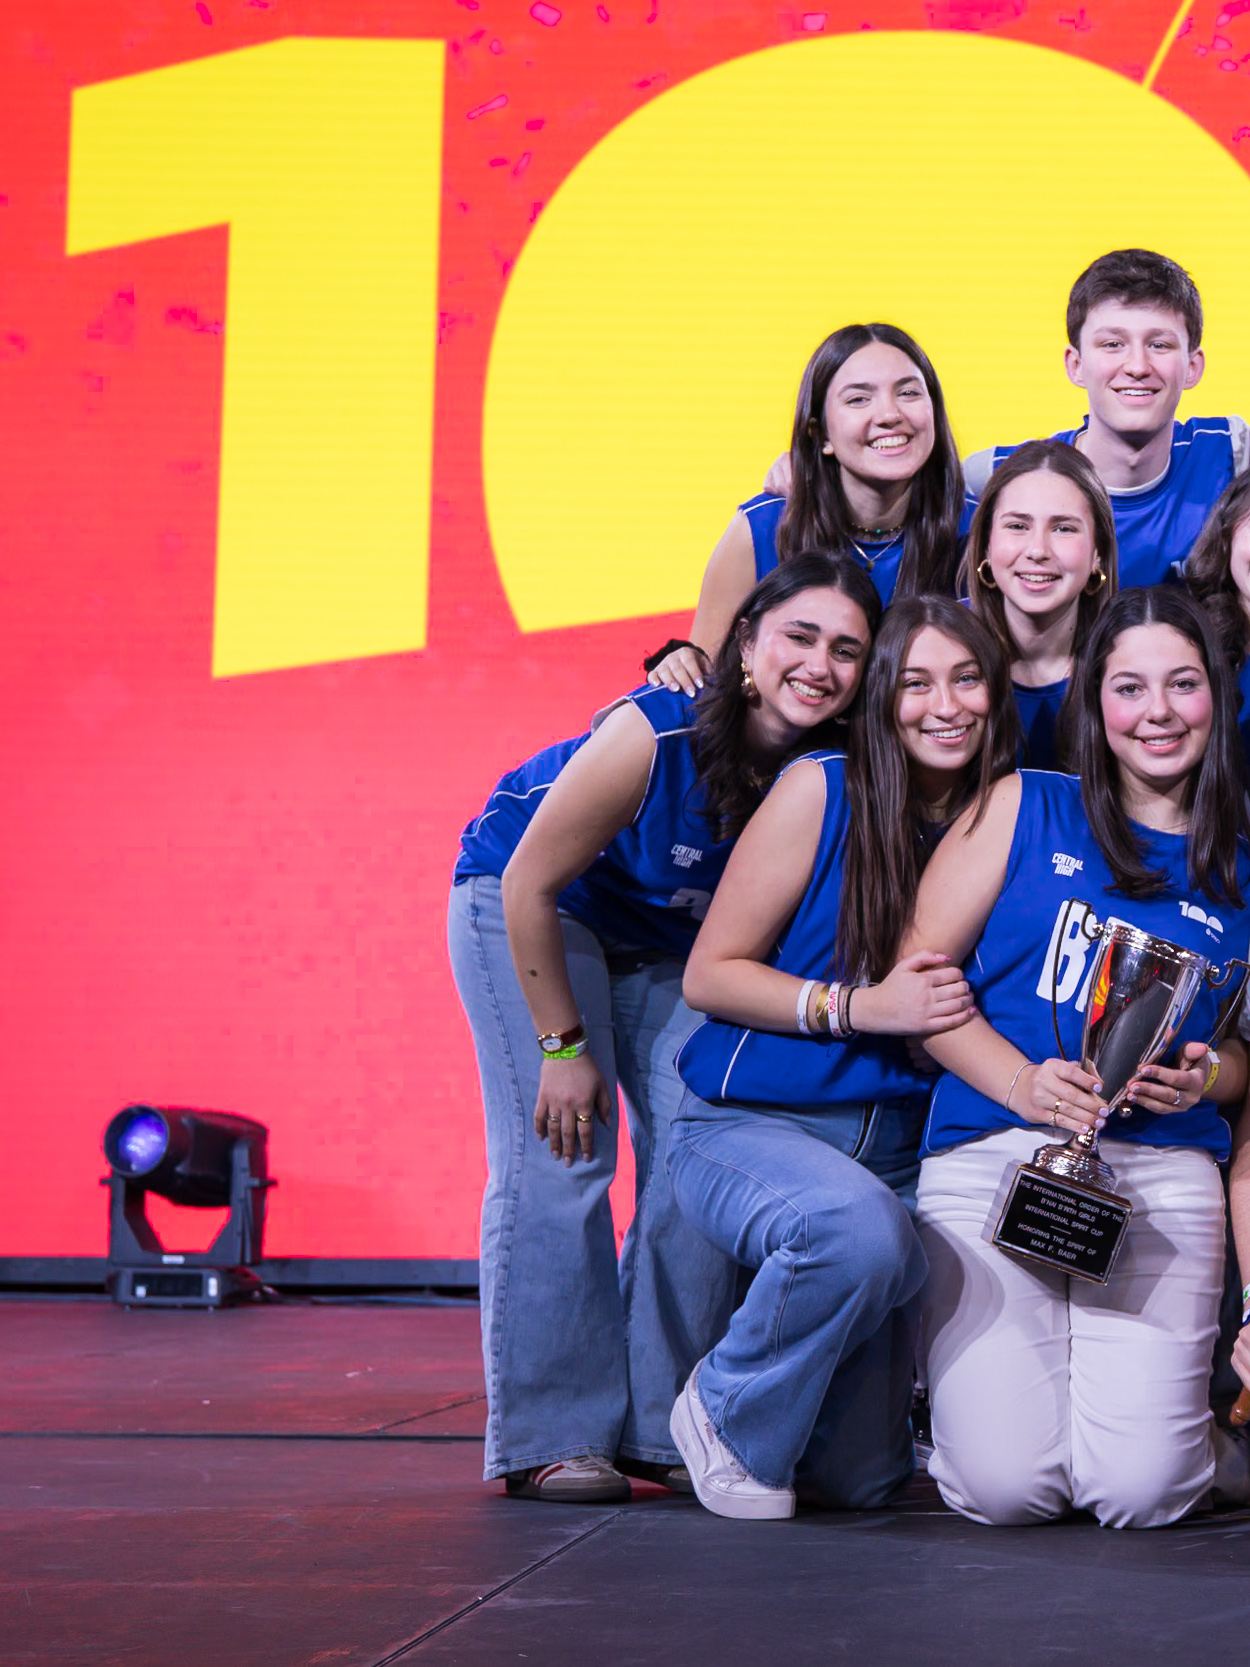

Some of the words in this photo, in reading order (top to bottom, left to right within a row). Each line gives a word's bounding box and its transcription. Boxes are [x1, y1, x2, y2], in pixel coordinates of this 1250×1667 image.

[670, 843, 703, 862] CENTRAL
[1051, 852, 1084, 871] CENTRAL
[1178, 900, 1224, 934] 100
[1020, 1180, 1032, 1189] THE
[1033, 1185, 1077, 1205] INTERNATIONAL
[1079, 1201, 1100, 1214] ORDER
[1112, 1213, 1124, 1223] THE
[1025, 1204, 1069, 1225] INTERNATIONAL
[1071, 1221, 1089, 1232] SPIRIT
[1090, 1228, 1104, 1237] CUP
[1078, 1211, 1096, 1223] GIRLS
[1017, 1223, 1050, 1239] HONORING
[1052, 1235, 1065, 1245] THE
[1066, 1240, 1086, 1252] SPIRIT
[1086, 1247, 1097, 1256] OF
[1030, 1238, 1046, 1250] MAX
[1047, 1244, 1054, 1254] F.
[1057, 1248, 1077, 1260] BAER
